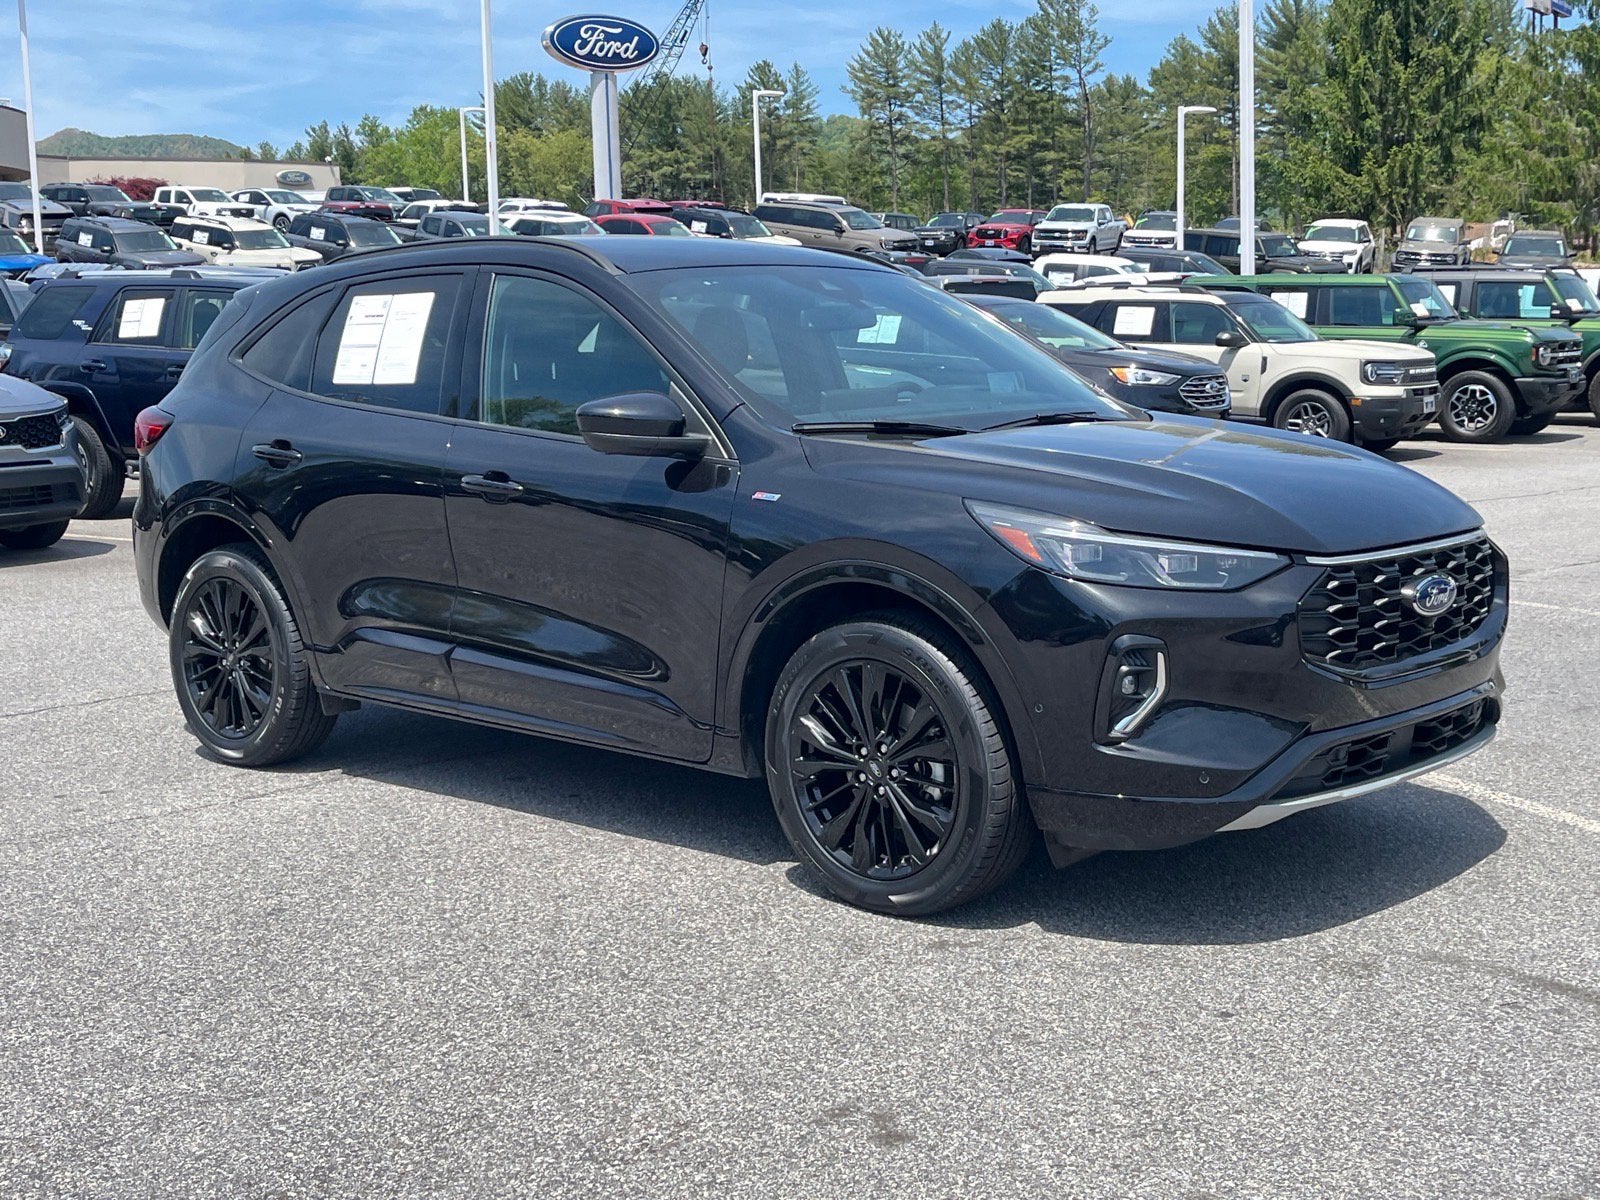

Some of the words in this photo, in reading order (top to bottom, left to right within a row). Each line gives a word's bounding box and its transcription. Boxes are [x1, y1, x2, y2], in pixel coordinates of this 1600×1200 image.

[574, 24, 639, 59] Ford
[286, 172, 305, 183] Ford
[1426, 584, 1454, 607] Ford
